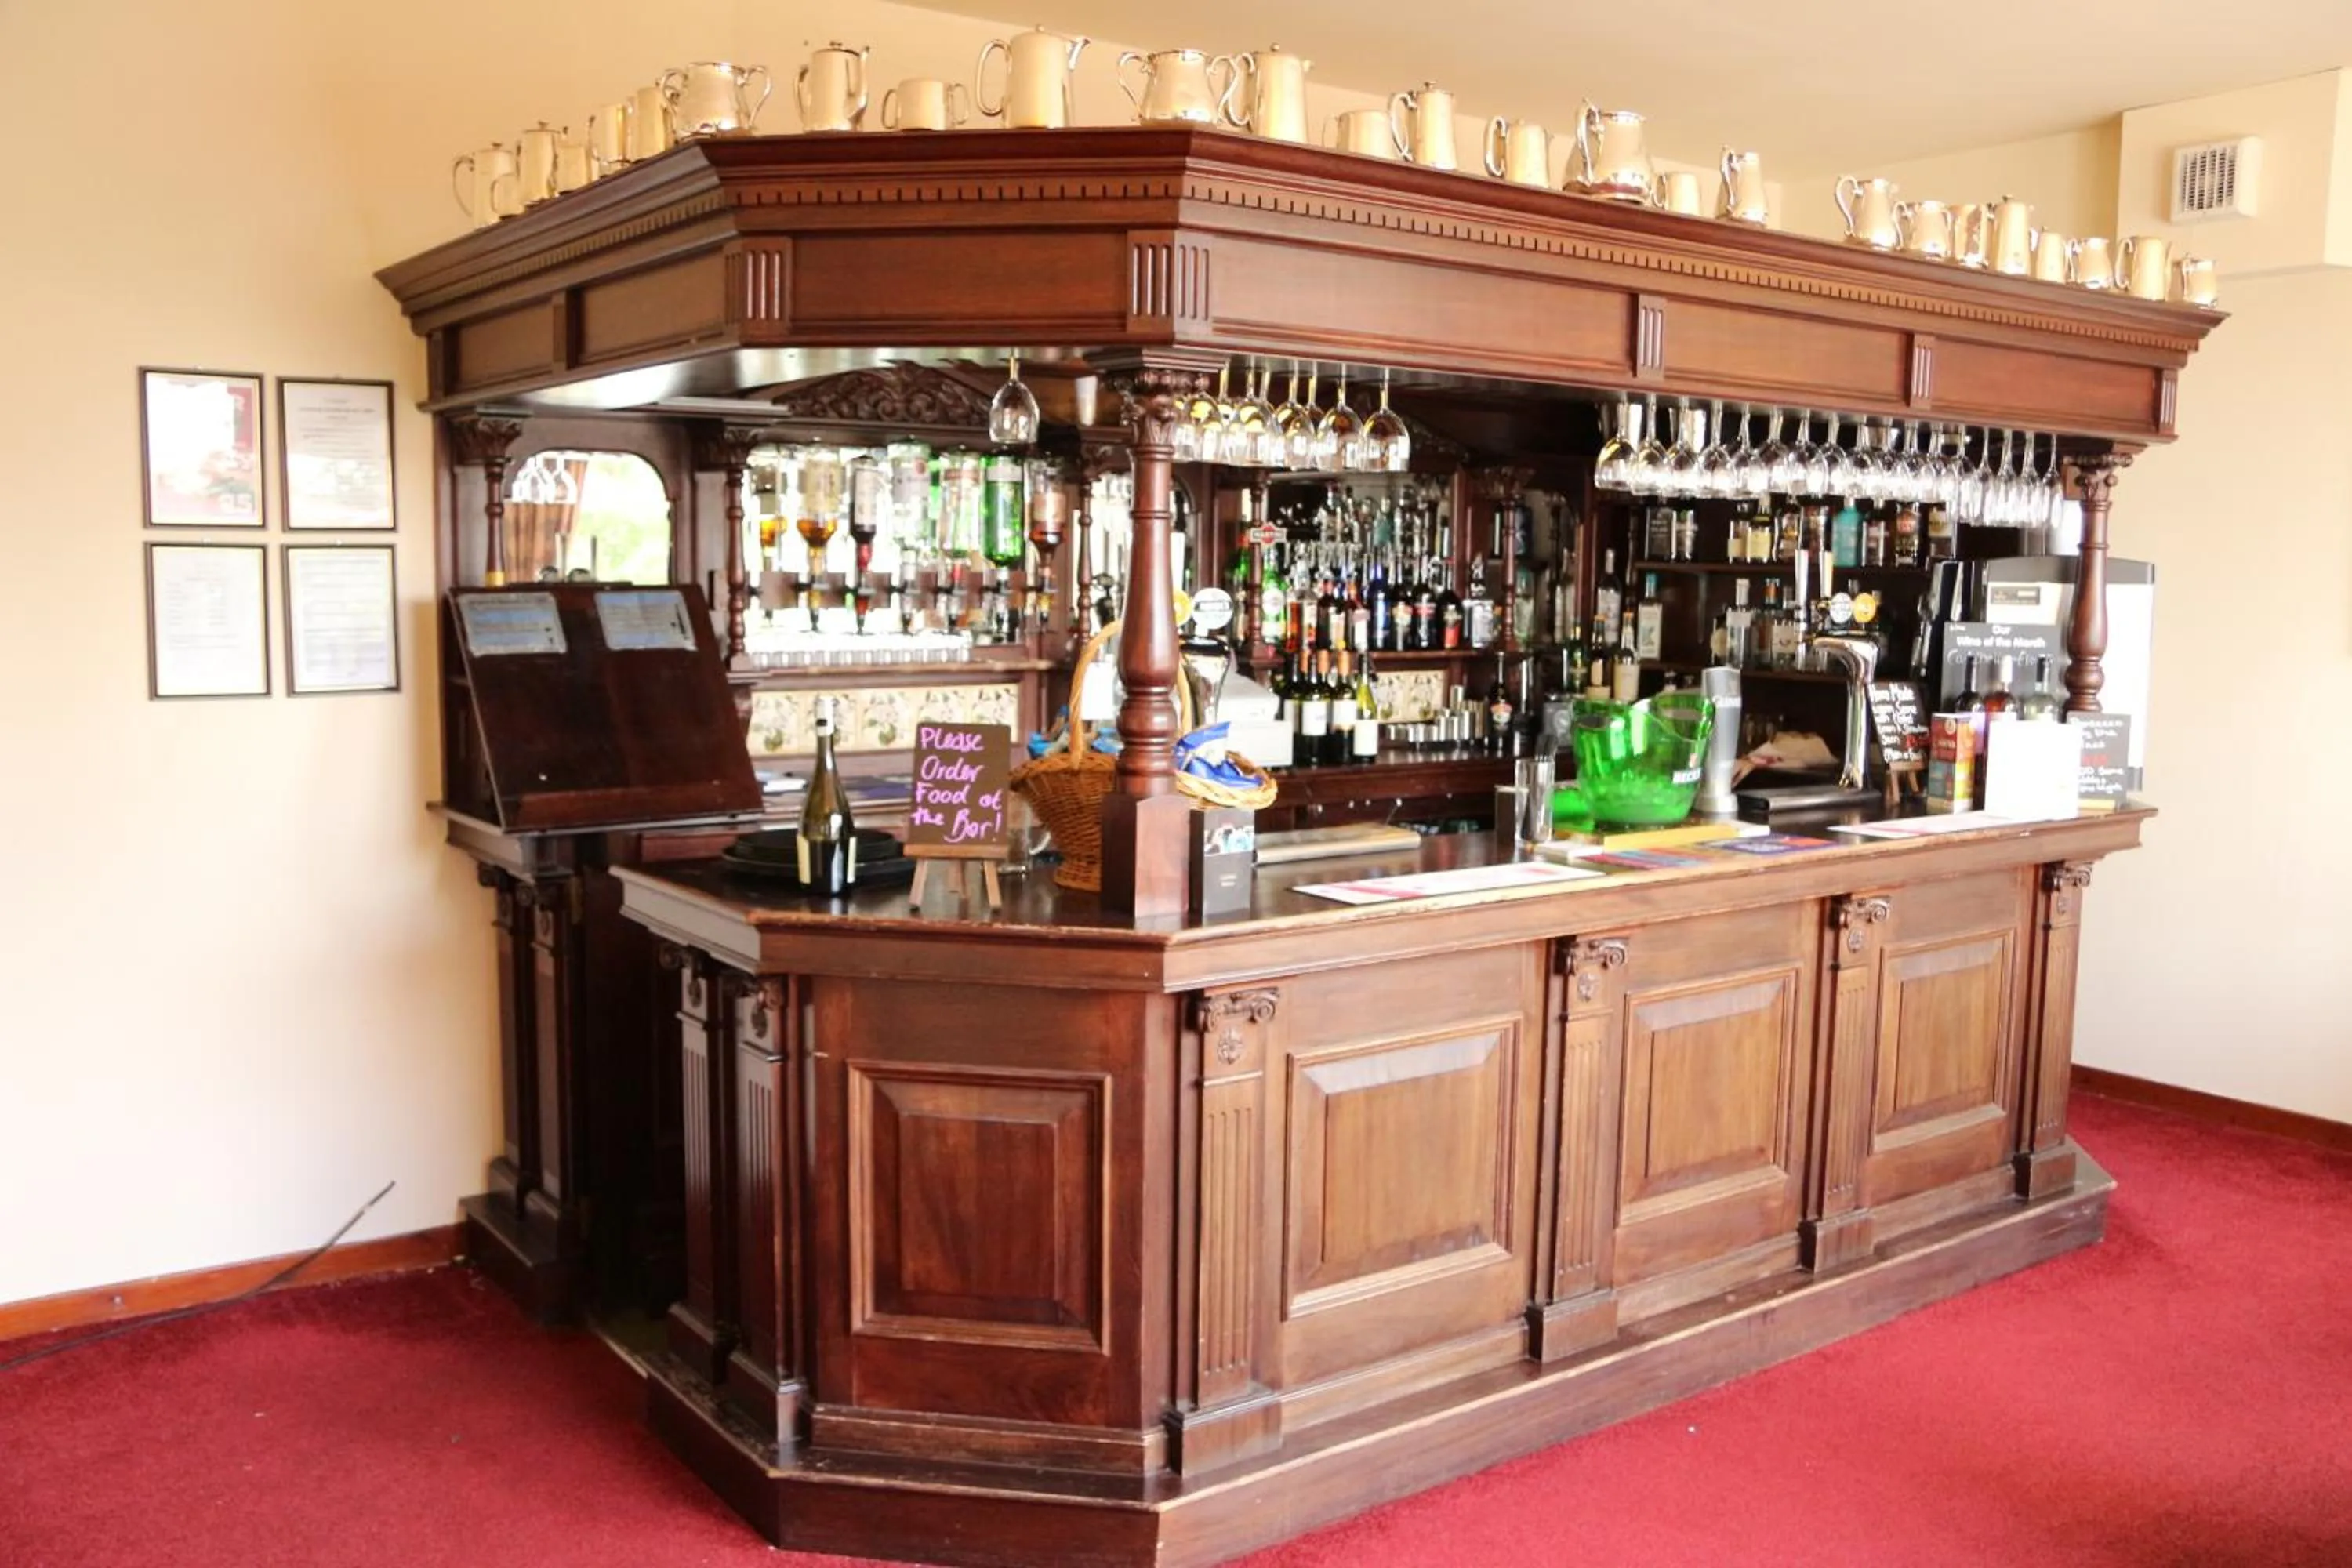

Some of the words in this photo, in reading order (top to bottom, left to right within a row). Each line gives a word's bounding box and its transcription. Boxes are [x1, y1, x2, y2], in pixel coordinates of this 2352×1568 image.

[1956, 636, 1982, 647] Wine
[1983, 636, 1994, 647] of
[1995, 636, 2012, 648] the
[2013, 637, 2046, 648] Month
[1992, 625, 2011, 635] Our
[920, 727, 985, 753] Please
[920, 755, 985, 782] Order
[915, 782, 971, 804] Food
[979, 788, 1003, 810] at
[910, 806, 945, 826] the
[943, 808, 1002, 843] Bar!
